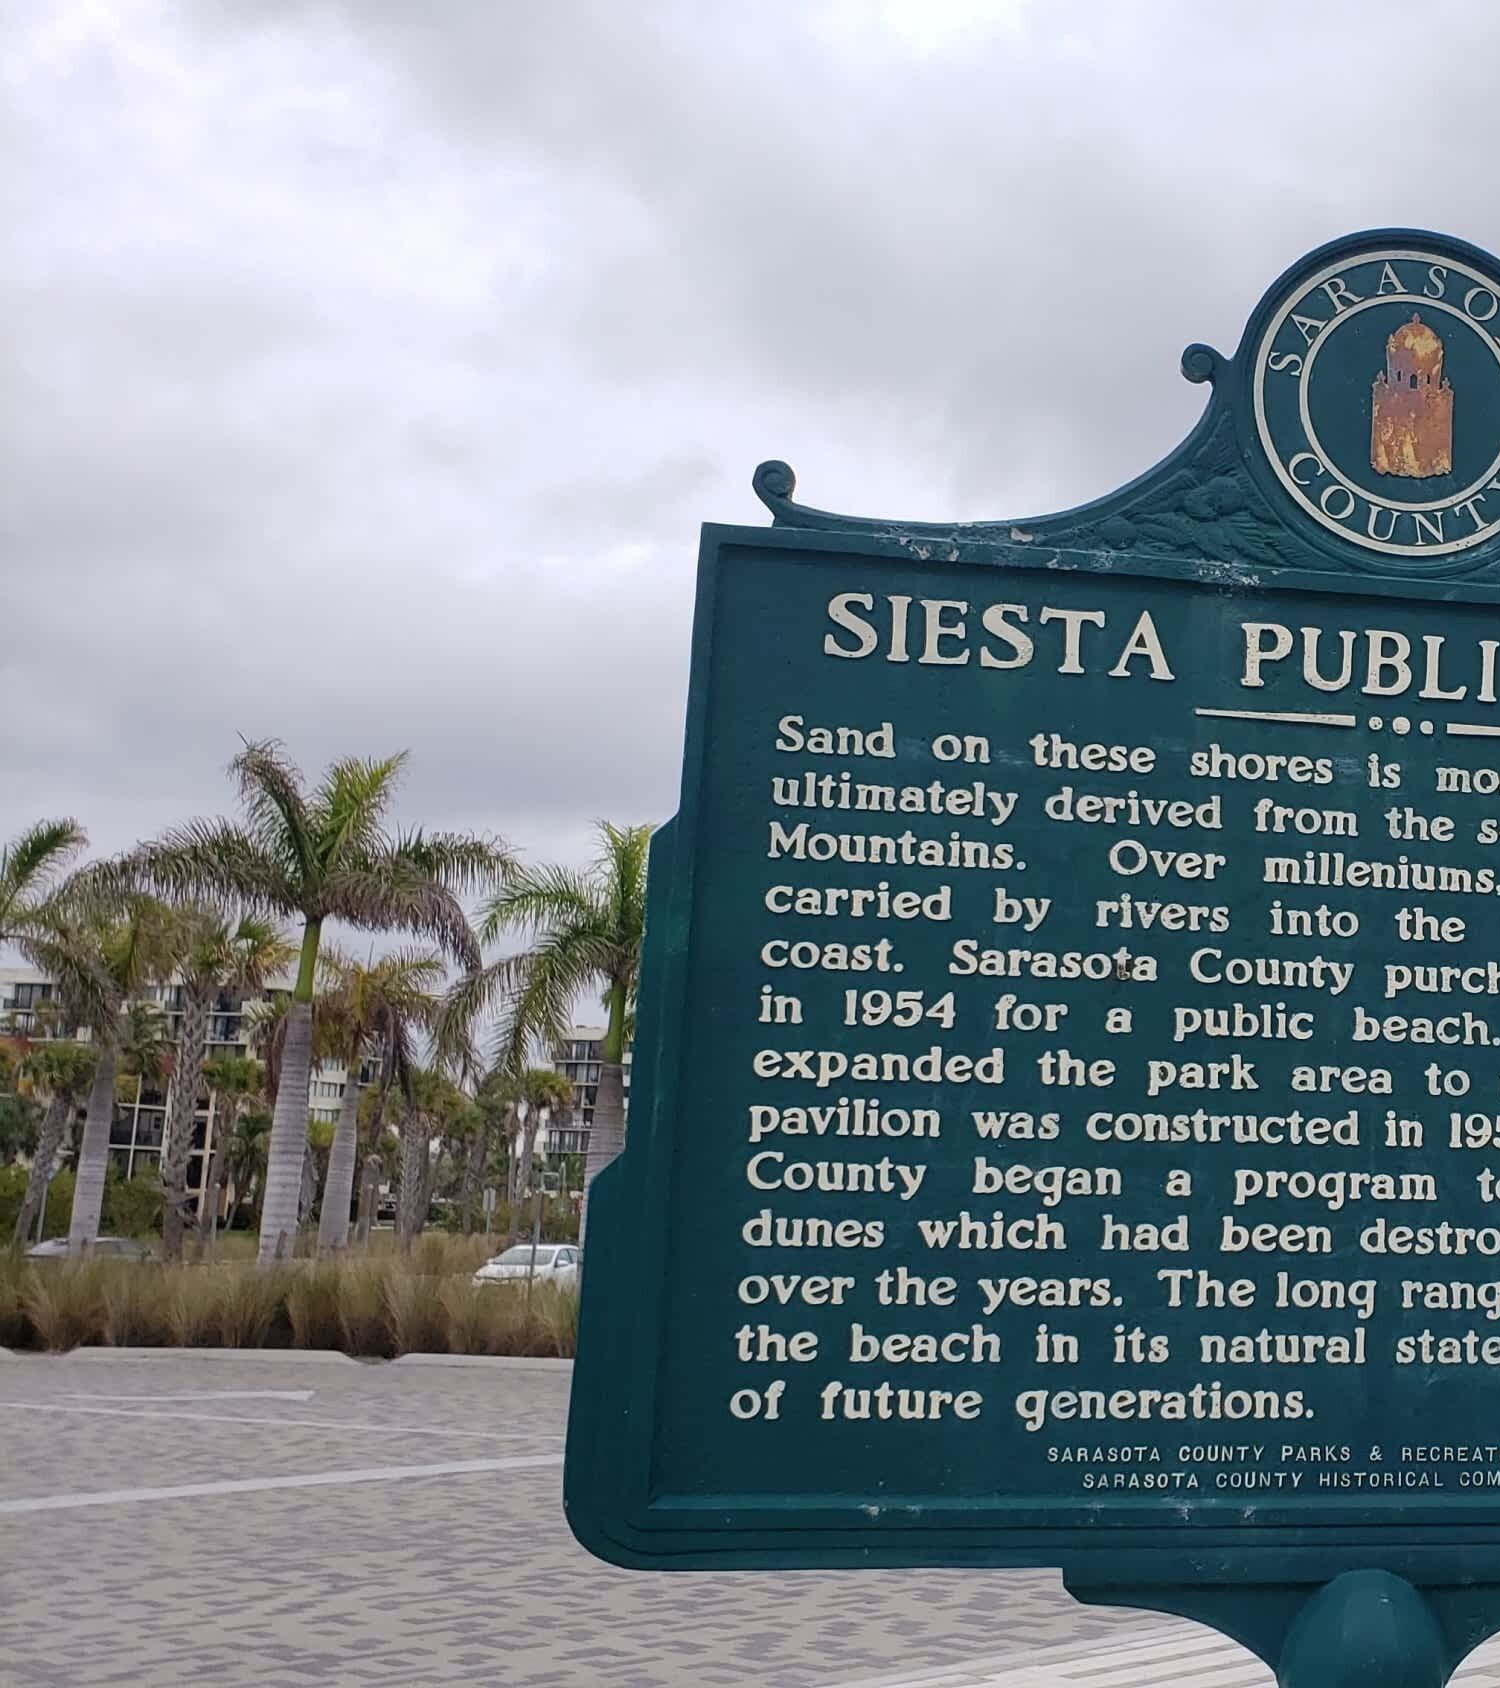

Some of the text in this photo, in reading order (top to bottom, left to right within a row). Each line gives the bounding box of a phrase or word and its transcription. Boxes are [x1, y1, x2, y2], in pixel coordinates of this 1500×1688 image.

[824, 592, 1176, 681] SIESTA
[775, 715, 897, 758] Sand
[931, 734, 991, 764] on
[1028, 733, 1156, 773] these
[1189, 743, 1333, 784] shores
[1367, 753, 1401, 789] is
[771, 771, 1019, 826] ultimately
[1044, 786, 1223, 829] derived
[1253, 798, 1359, 837] from
[1383, 806, 1455, 842] the
[767, 821, 1026, 870] Mountains.
[1109, 839, 1226, 880] Over
[764, 881, 952, 921] carried
[992, 887, 1052, 932] by
[1095, 892, 1230, 932] rivers
[1269, 900, 1359, 937] into
[1394, 907, 1466, 943] the
[761, 938, 904, 973] coast.
[948, 939, 1158, 982] Sarasota
[1189, 947, 1355, 996] County
[758, 984, 803, 1024] in
[844, 989, 956, 1029] 1954
[994, 993, 1068, 1032] for
[1105, 1007, 1132, 1034] a
[1173, 1001, 1314, 1042] public
[753, 1046, 1005, 1088] expanded
[1036, 1049, 1116, 1087] the
[1147, 1053, 1259, 1097] park
[1291, 1065, 1393, 1094] area
[1424, 1062, 1471, 1097] to
[748, 1096, 941, 1143] pavilion
[971, 1111, 1060, 1140] was
[1085, 1108, 1360, 1146] constructed
[1384, 1110, 1423, 1148] in
[746, 1151, 927, 1201] County
[972, 1156, 1122, 1207] began
[1165, 1169, 1192, 1197] a
[1233, 1169, 1438, 1211] program
[742, 1208, 885, 1248] dunes
[917, 1210, 1067, 1250] which
[1100, 1214, 1190, 1252] had
[1219, 1215, 1332, 1253] been
[738, 1274, 855, 1305] over
[874, 1266, 957, 1306] the
[977, 1276, 1123, 1315] years.
[1157, 1268, 1256, 1308] The
[1275, 1271, 1377, 1320] long
[735, 1324, 818, 1362] the
[849, 1322, 1001, 1363] beach
[1035, 1323, 1079, 1363] in
[1113, 1324, 1169, 1363] its
[1199, 1326, 1366, 1364] natural
[729, 1379, 1314, 1432] of future generations.
[1048, 1446, 1161, 1462] SARASOTA
[1178, 1445, 1265, 1462] COUNTY
[1281, 1445, 1350, 1462] PARKS
[1369, 1445, 1382, 1461] &
[1083, 1472, 1199, 1489] SARASOTA
[1215, 1471, 1303, 1489] COUNTY
[1319, 1471, 1443, 1487] HISTORICAL
